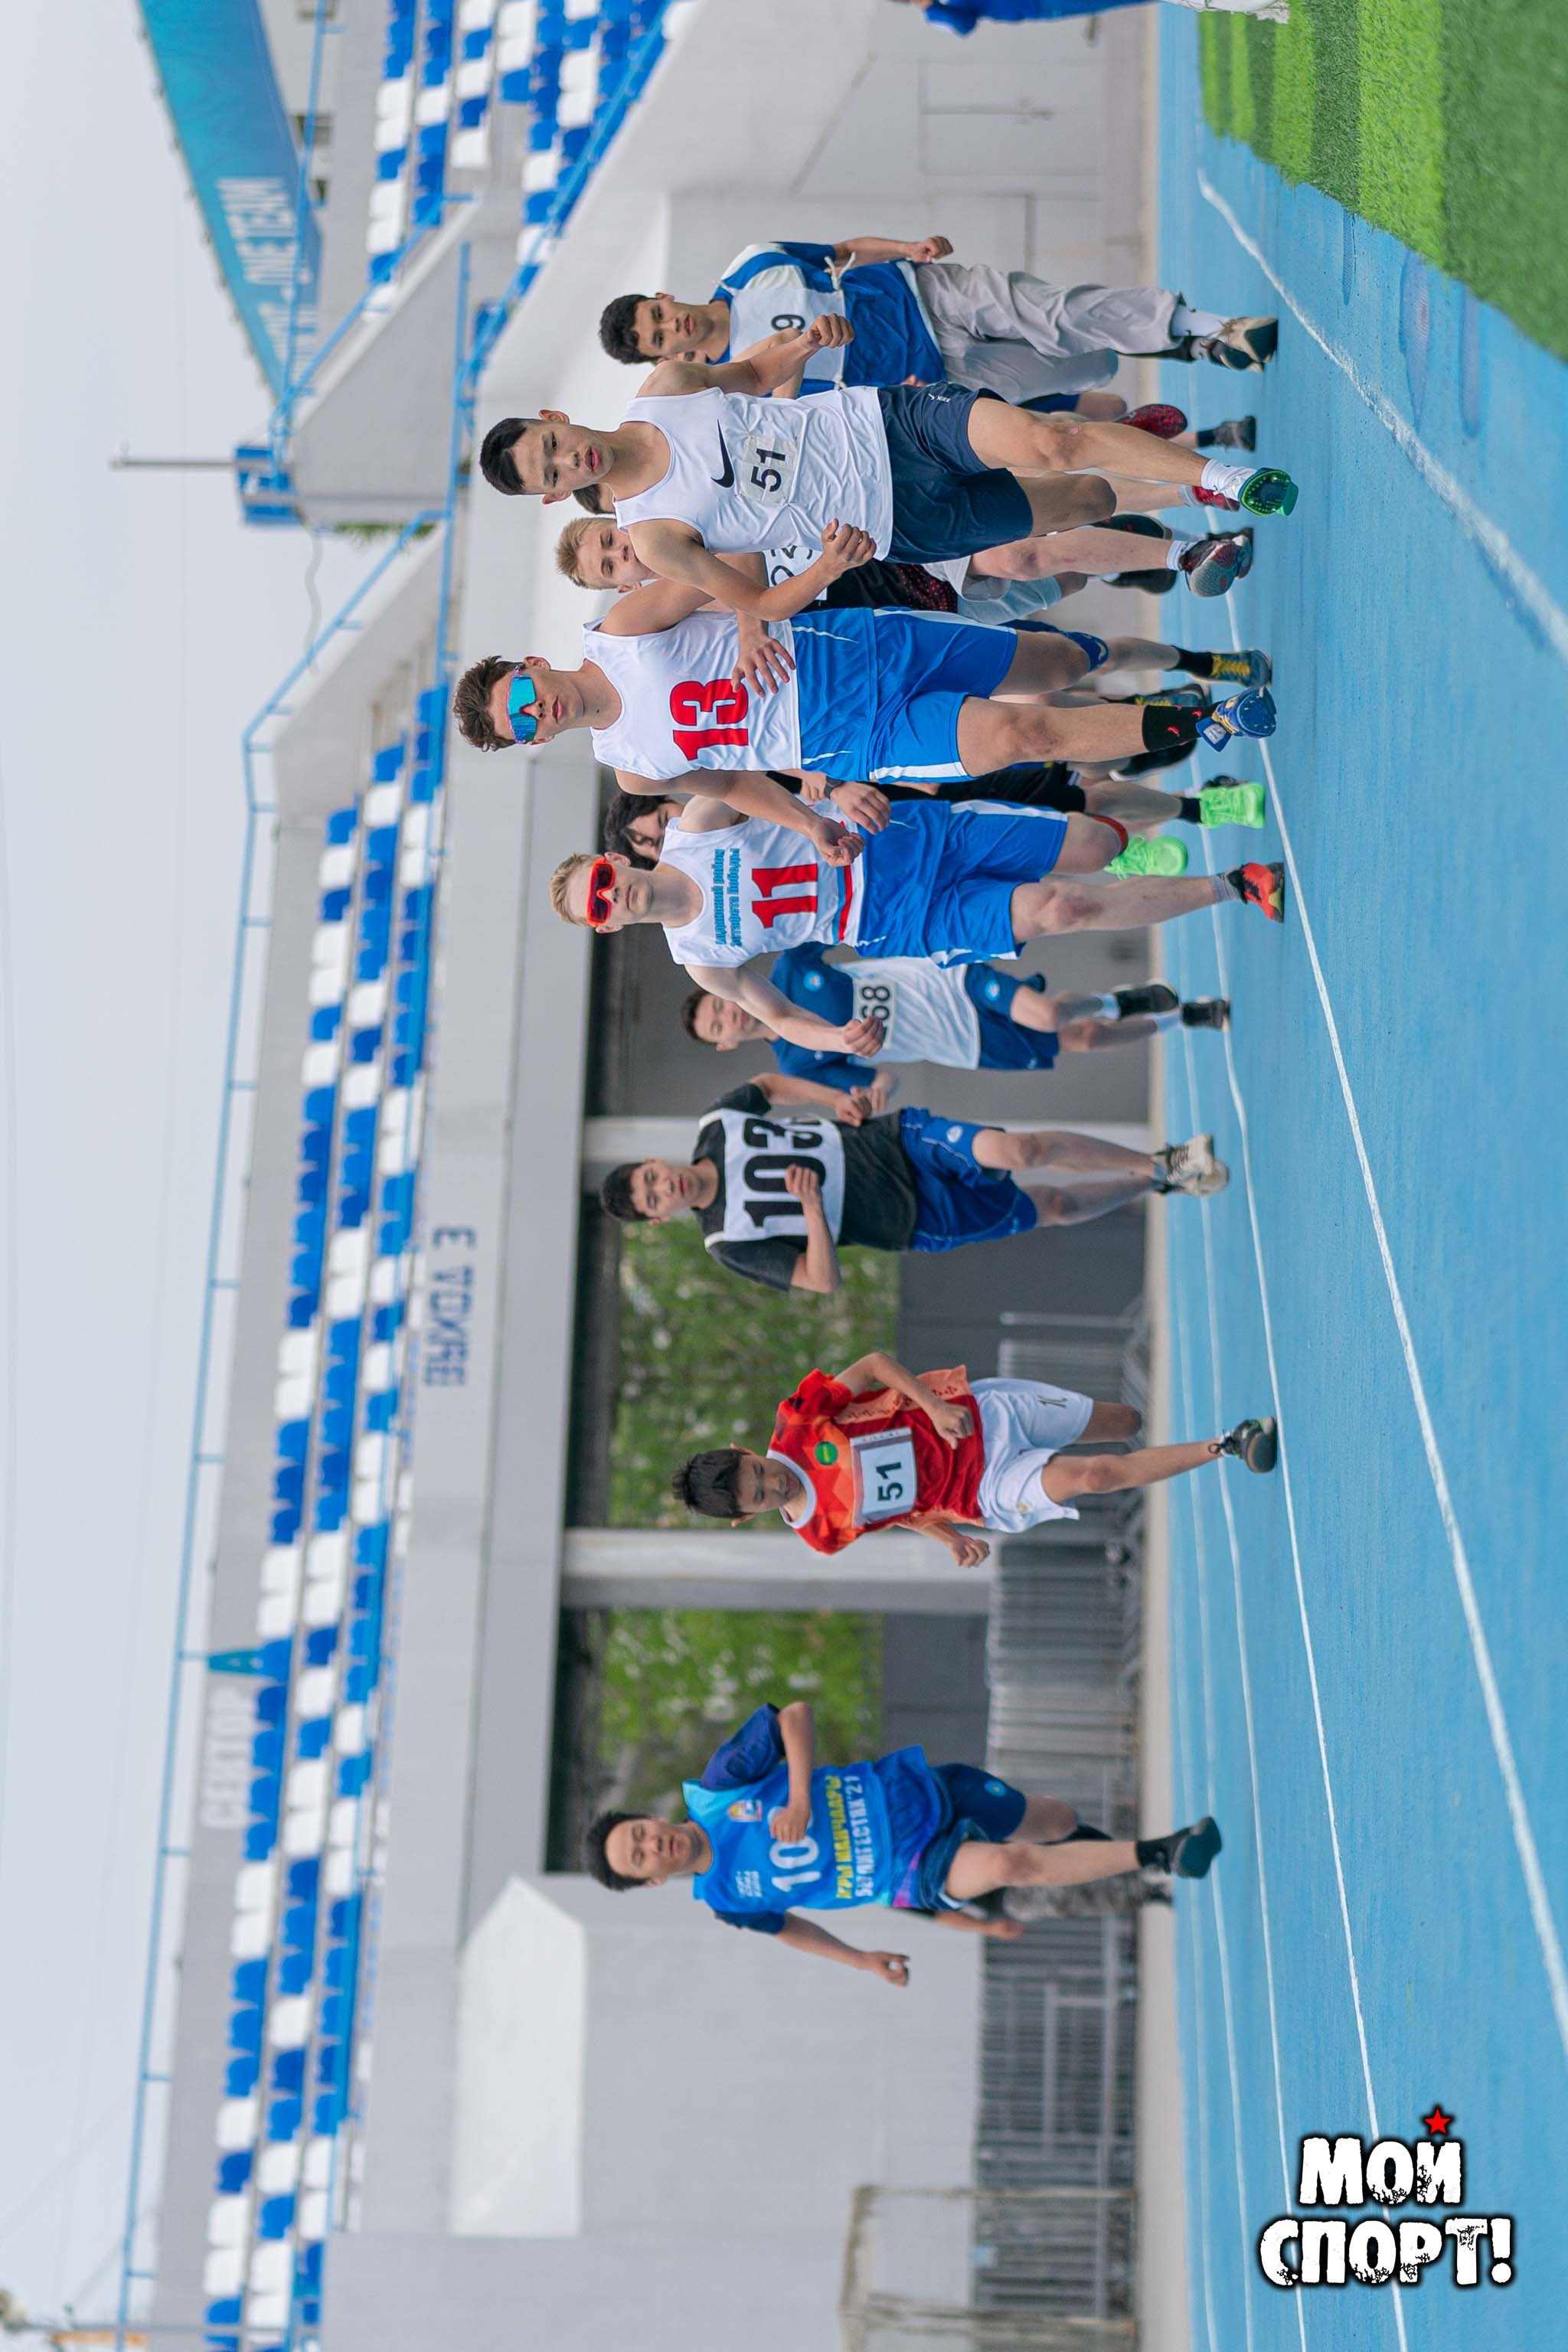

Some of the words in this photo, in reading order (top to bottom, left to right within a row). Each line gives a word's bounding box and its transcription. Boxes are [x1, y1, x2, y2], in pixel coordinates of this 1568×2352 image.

[215, 177, 299, 238] TEAM
[751, 447, 786, 492] 51
[669, 678, 750, 760] 13
[752, 862, 818, 928] 11
[859, 985, 890, 1041] 68
[742, 1116, 826, 1227] 103
[875, 1461, 910, 1501] 51
